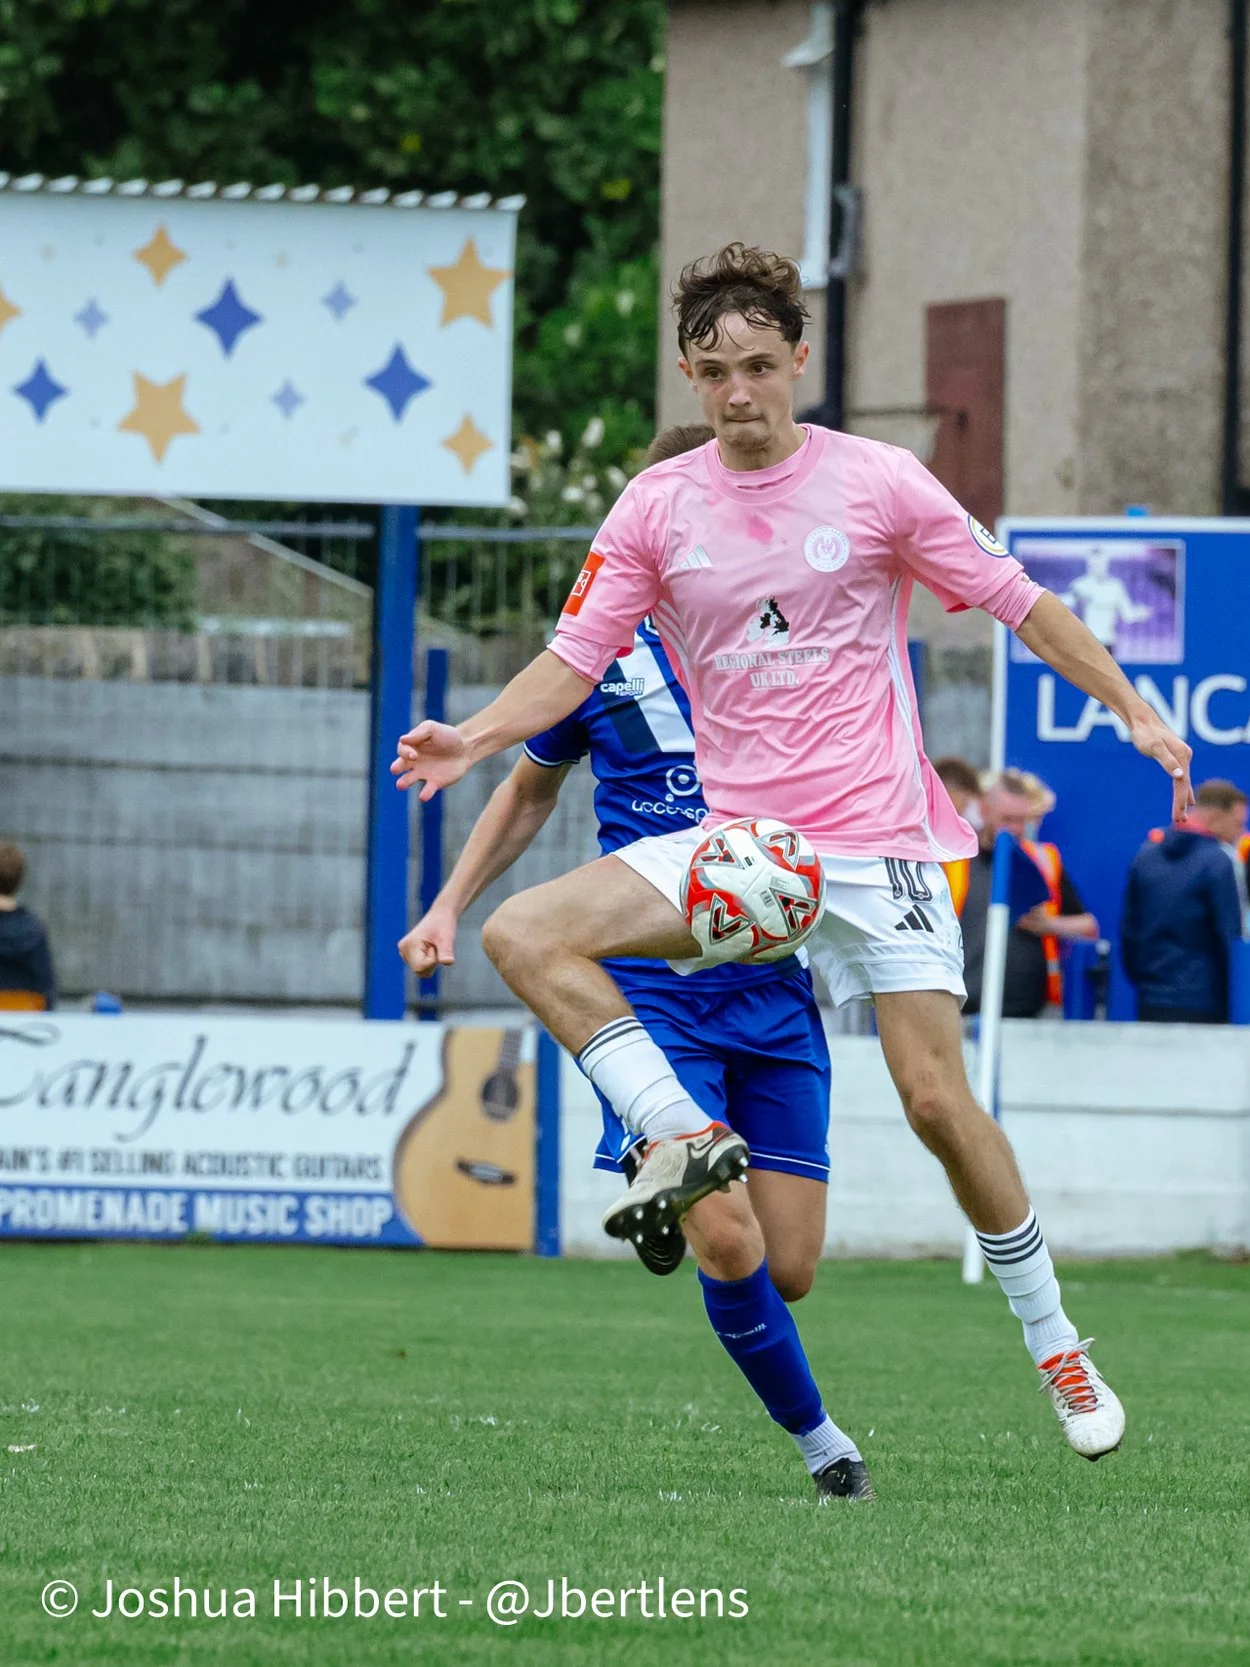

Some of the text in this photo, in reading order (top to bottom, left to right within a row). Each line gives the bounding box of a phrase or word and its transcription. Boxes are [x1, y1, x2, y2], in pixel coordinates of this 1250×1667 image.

[714, 646, 831, 671] REGIONAL STEELS
[600, 678, 644, 696] capelli
[750, 669, 801, 689] UK LTD.
[90, 1150, 174, 1176] SELLING
[183, 1151, 286, 1178] ACOUSTIC
[293, 1153, 383, 1180] GUITARS
[195, 1191, 299, 1237] MUSIC
[303, 1194, 393, 1239] SHOP
